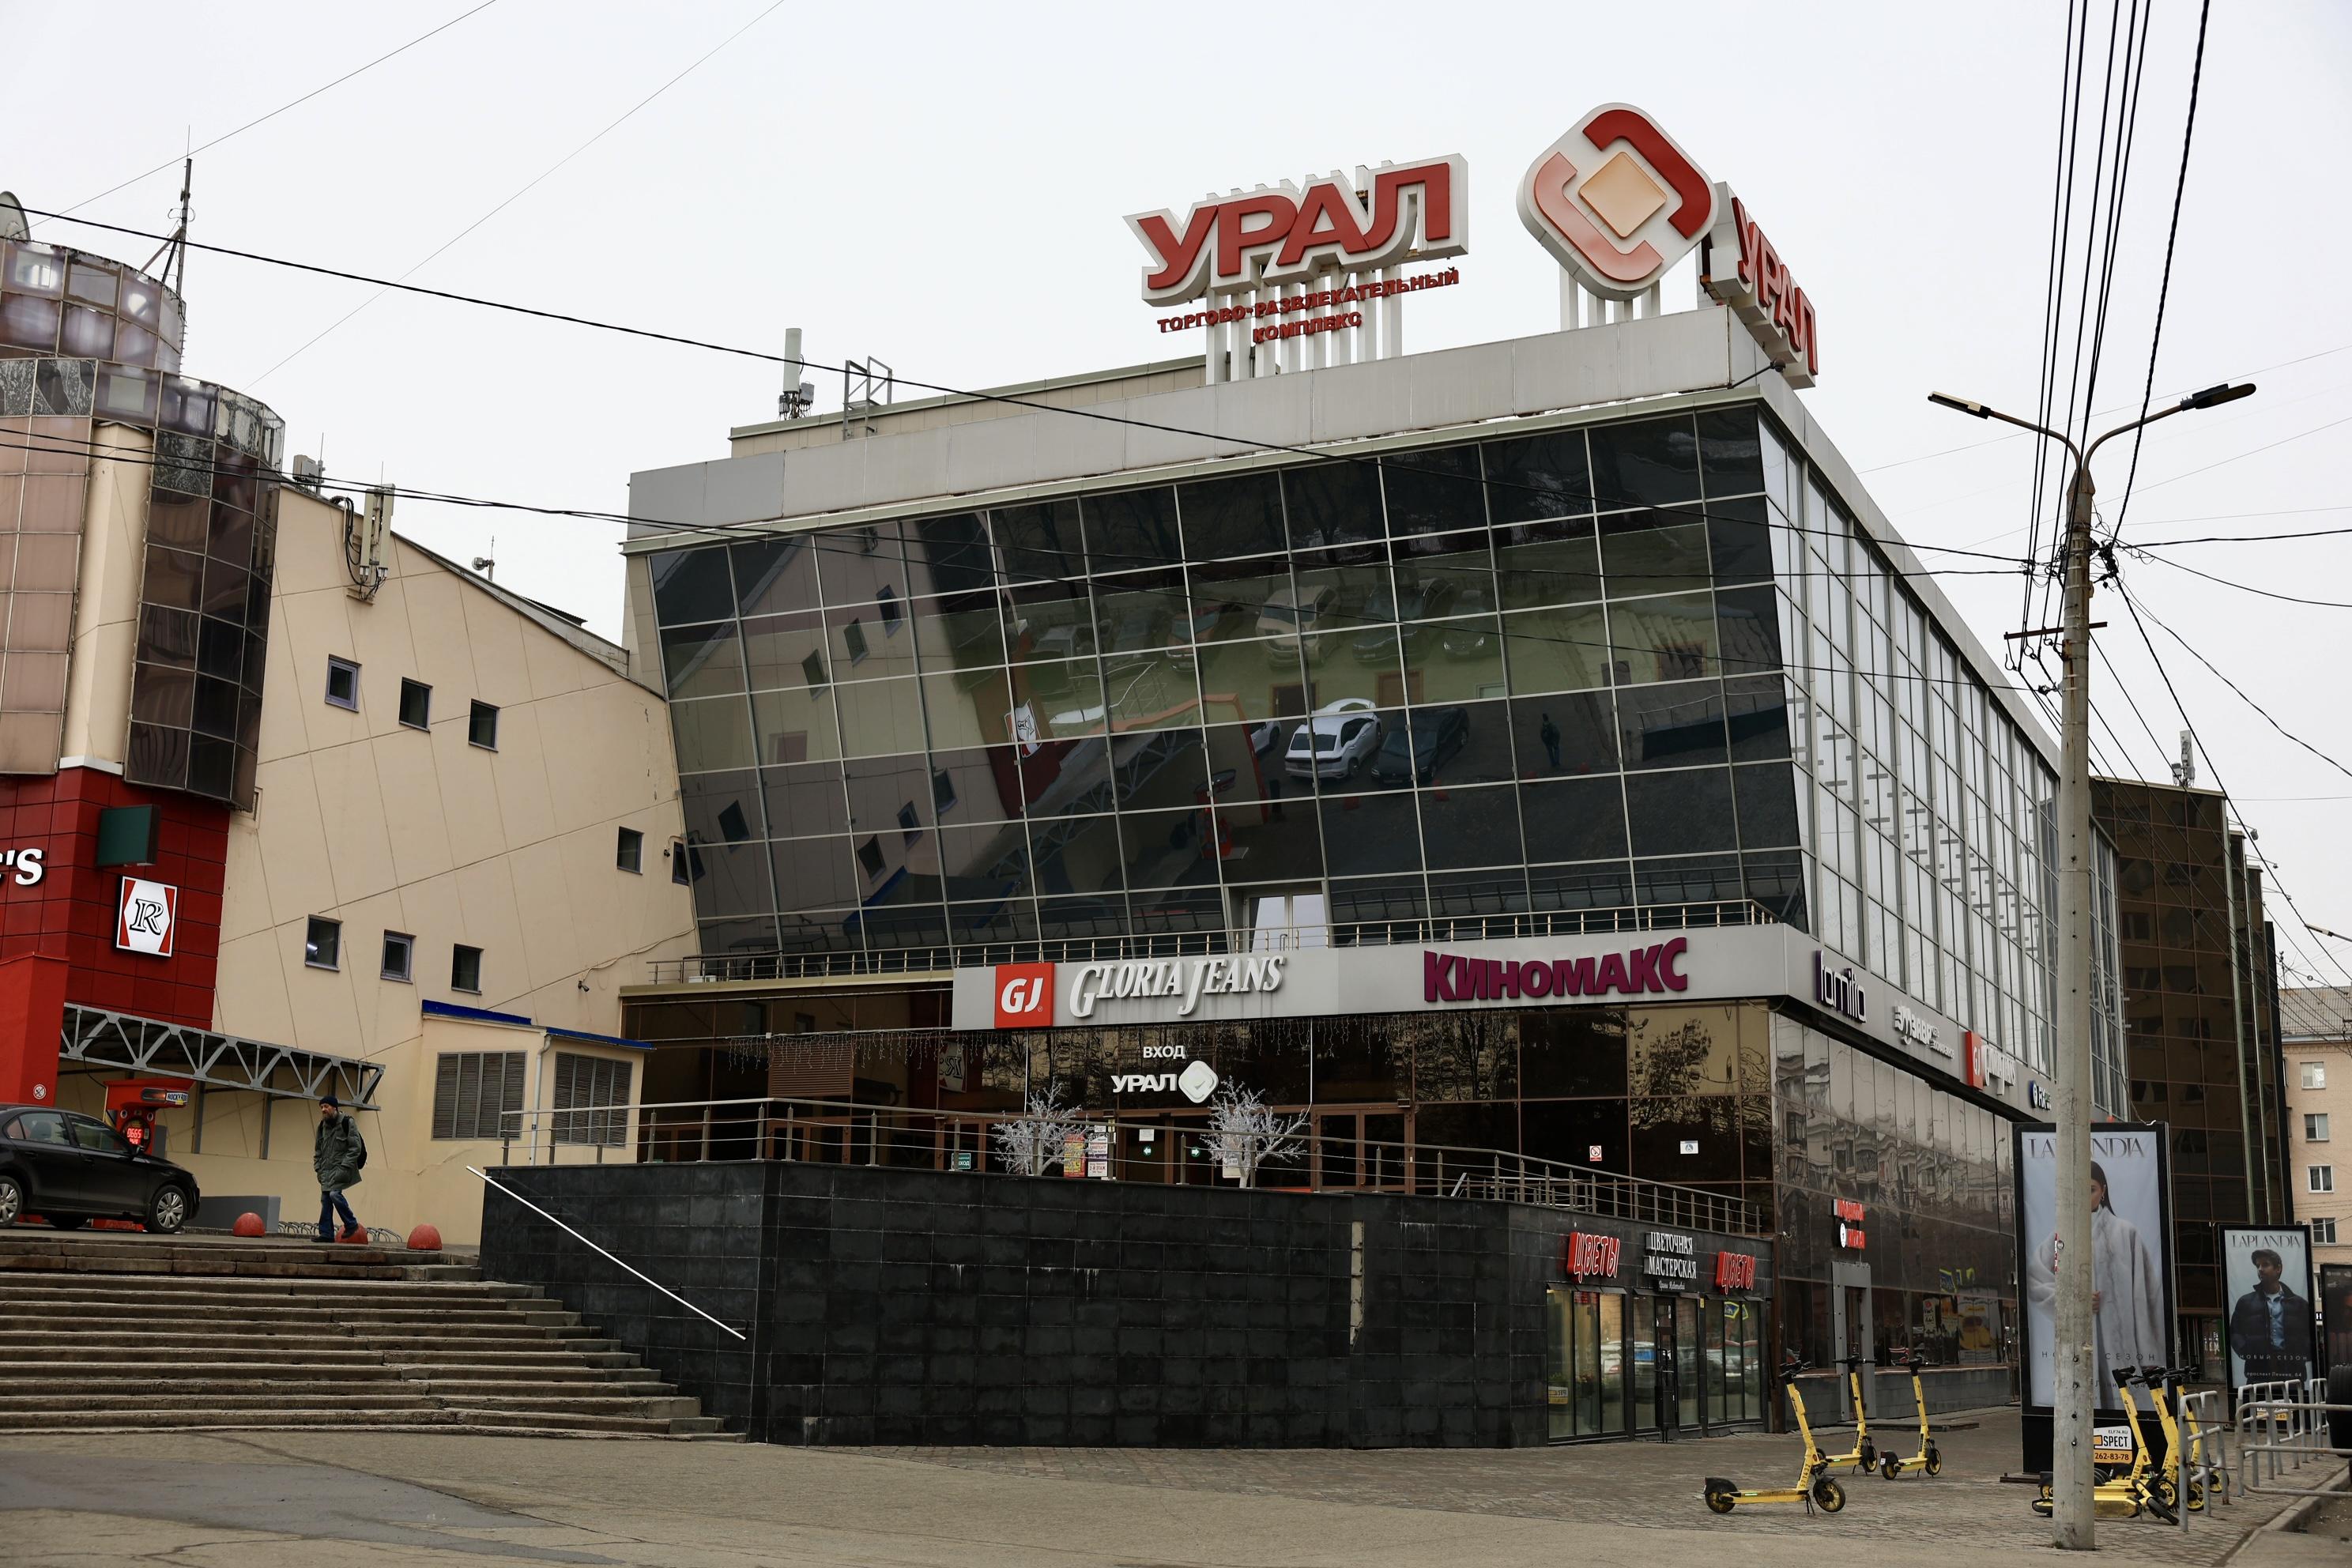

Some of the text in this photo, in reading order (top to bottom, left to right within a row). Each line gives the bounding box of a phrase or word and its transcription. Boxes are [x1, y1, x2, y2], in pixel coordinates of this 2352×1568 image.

[1136, 162, 1450, 290] УРАЛ
[1157, 267, 1460, 334] ТОРГОВО-РАЗВЛЕКАТЕЛЬНЫЙ
[1732, 196, 1818, 375] УРАЛ
[1253, 311, 1363, 343] КОМПЛЕКС
[129, 898, 164, 937] R
[1069, 955, 1287, 1019] GLORIA JEANS
[1424, 937, 1687, 1001] КИНОМАКС
[1001, 977, 1043, 1014] GJ
[1143, 1044, 1185, 1060] ВХОД
[1111, 1073, 1177, 1093] УРАЛ
[1573, 1231, 1619, 1283] ЦВЕТЫ
[1650, 1231, 1693, 1255] ЦВЕТОЧНАЯ
[2232, 1234, 2301, 1248] LAPLANDIA
[1649, 1255, 1697, 1279] МАСТЕРСКАЯ
[1721, 1251, 1755, 1295] ЦВЕТЫ
